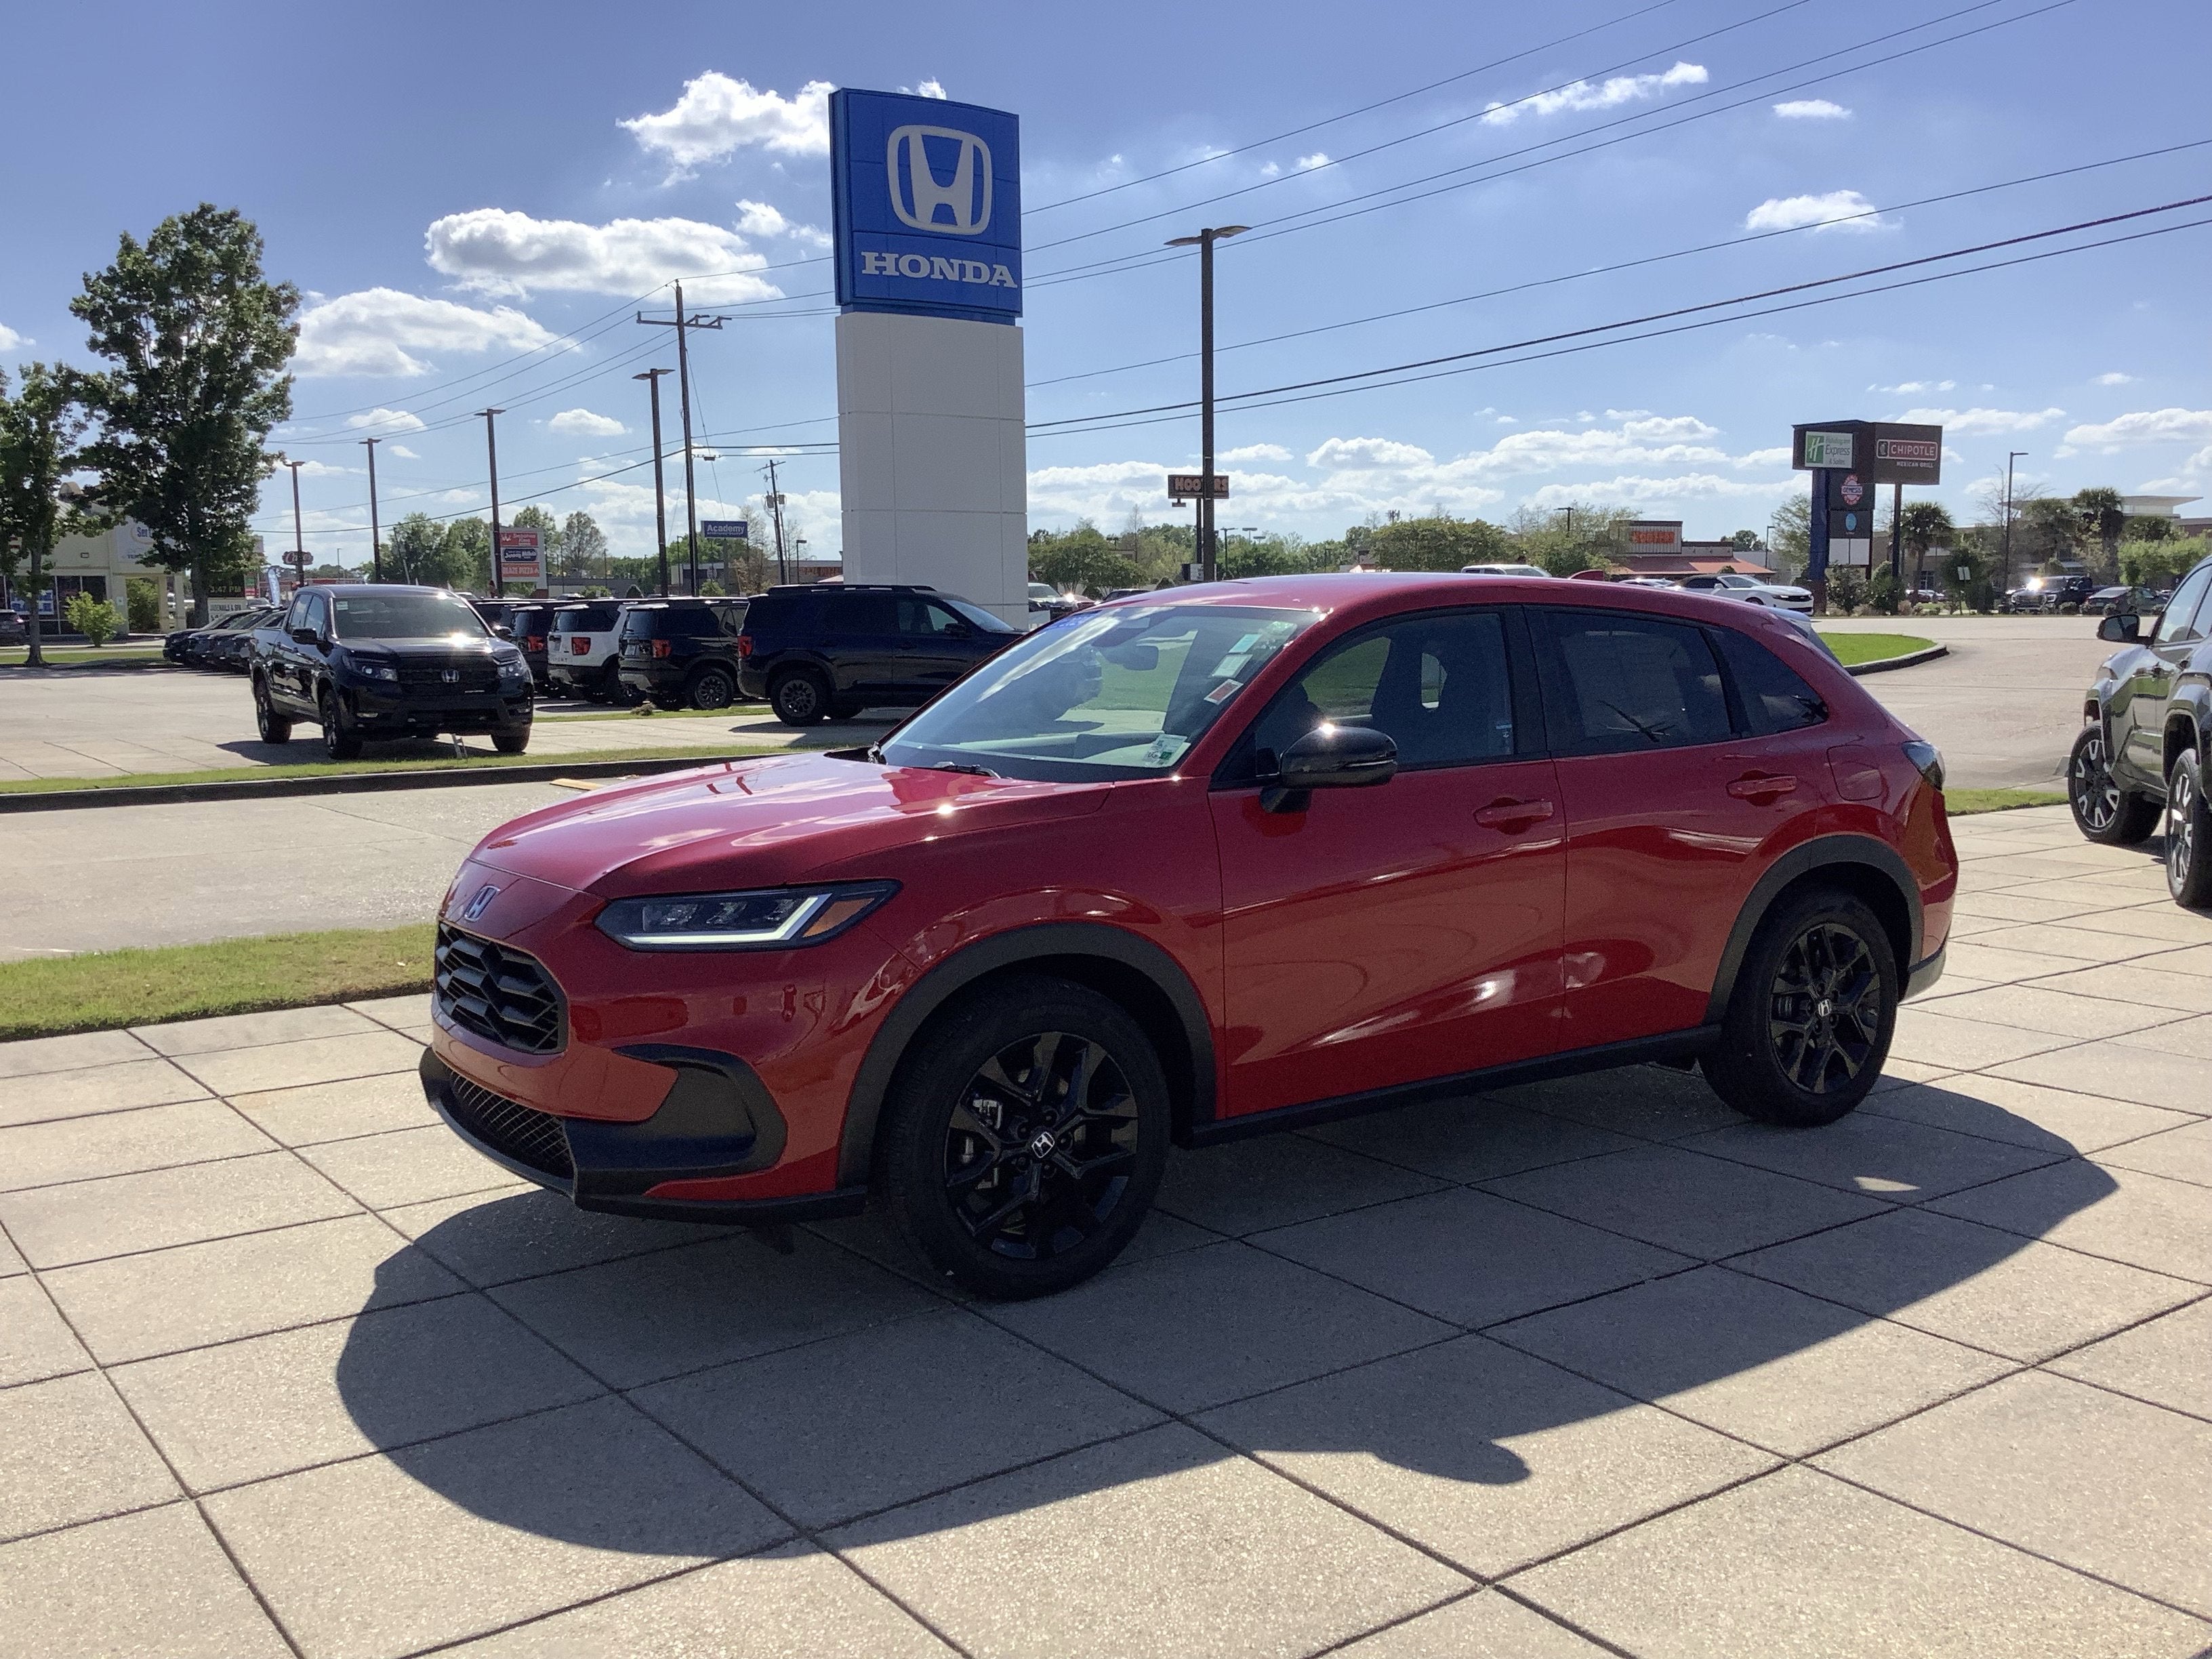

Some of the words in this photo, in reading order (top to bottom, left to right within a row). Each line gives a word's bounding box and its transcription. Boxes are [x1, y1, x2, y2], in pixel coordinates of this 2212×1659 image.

[861, 251, 1018, 288] HONDA
[1825, 444, 1850, 457] Express
[1891, 445, 1935, 456] CHIPOTLE
[1174, 477, 1228, 491] HOORS
[707, 524, 745, 535] Academy
